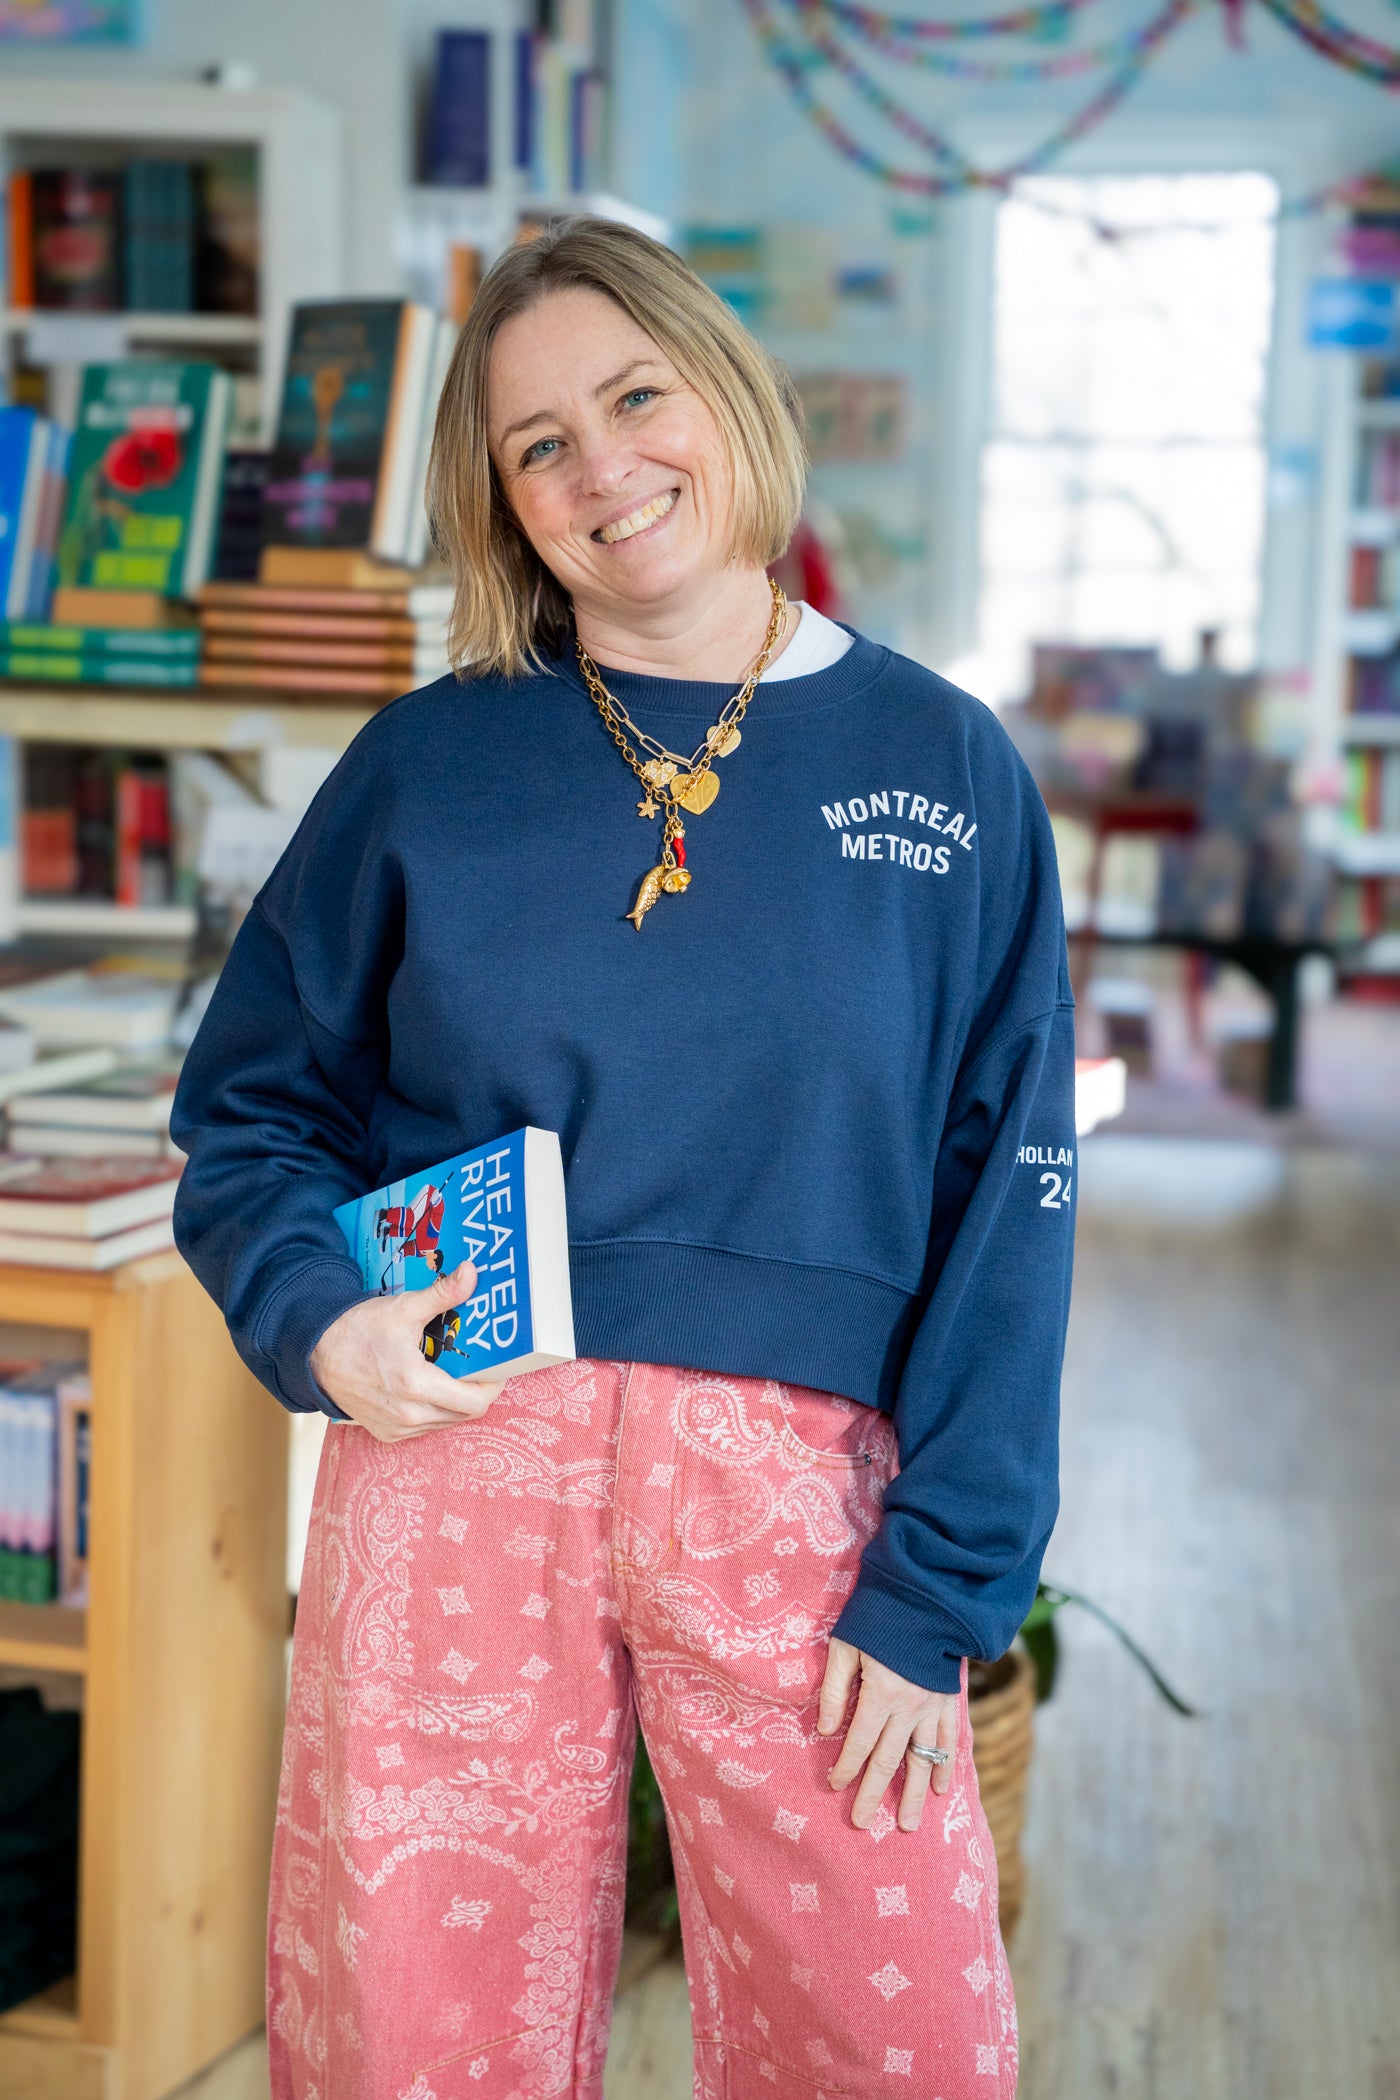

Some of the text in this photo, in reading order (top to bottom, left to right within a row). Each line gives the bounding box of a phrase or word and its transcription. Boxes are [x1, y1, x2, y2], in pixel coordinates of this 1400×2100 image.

[821, 790, 978, 851] MONTREAL
[841, 833, 952, 875] METROS
[1039, 1171, 1072, 1212] 24
[485, 1147, 518, 1349] HEATED
